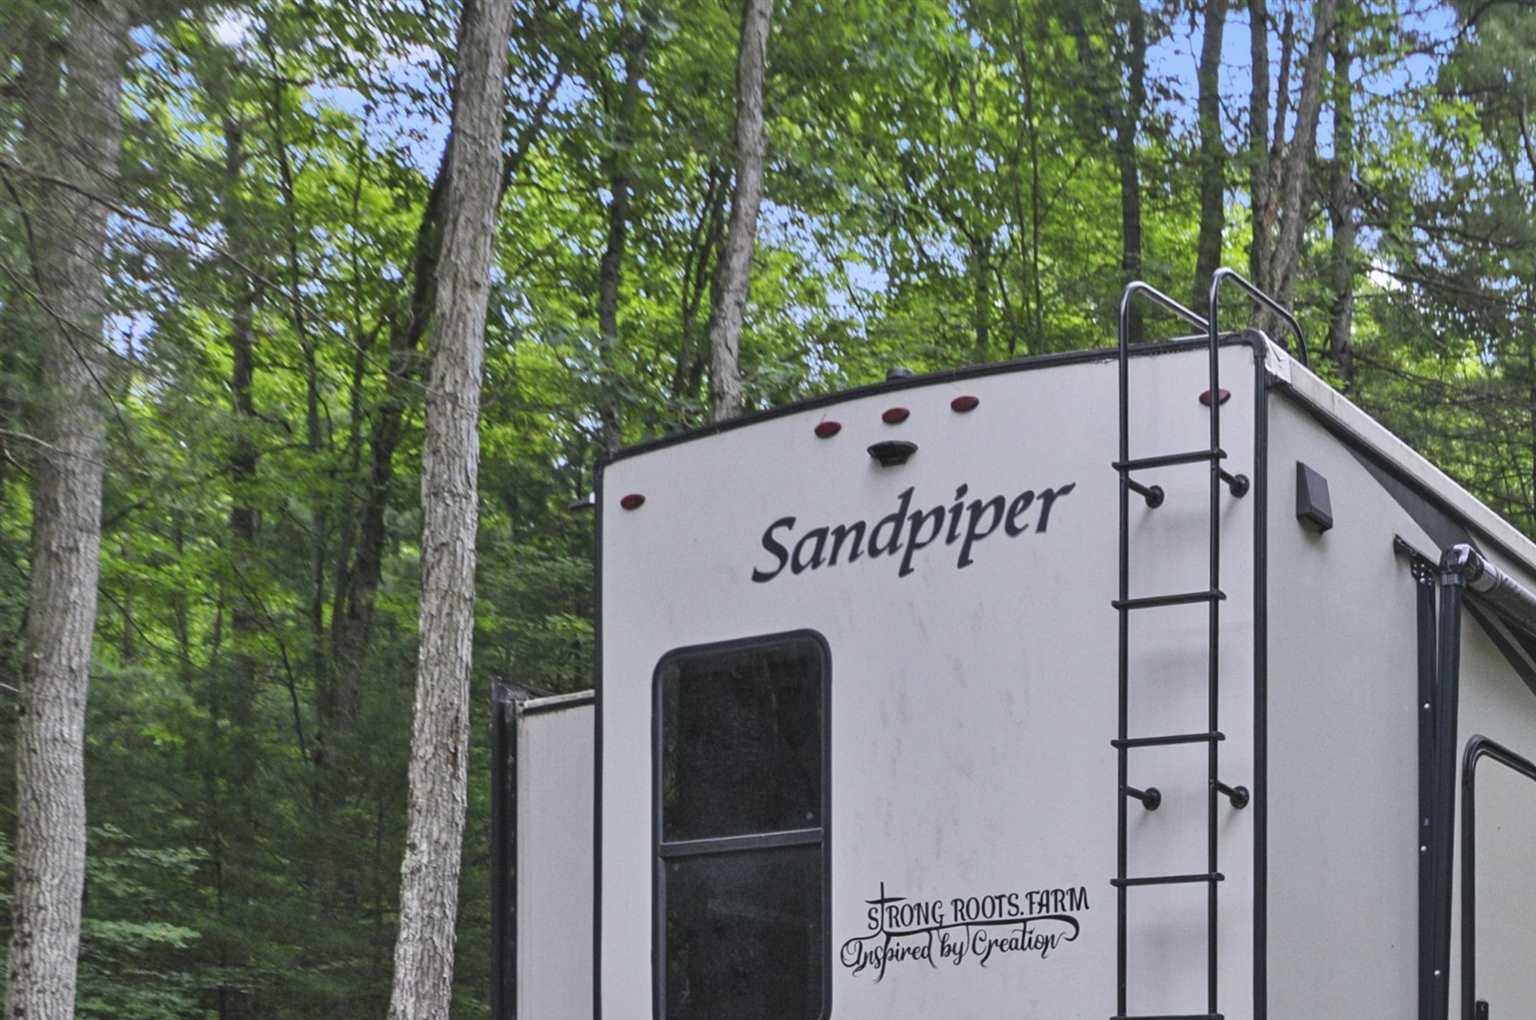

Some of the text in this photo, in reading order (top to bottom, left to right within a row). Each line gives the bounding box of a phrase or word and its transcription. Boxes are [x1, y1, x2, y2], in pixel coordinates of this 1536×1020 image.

[751, 482, 1076, 583] Sandpiper
[864, 881, 944, 931] STRONG
[840, 921, 1066, 982] Inspired by Creation
